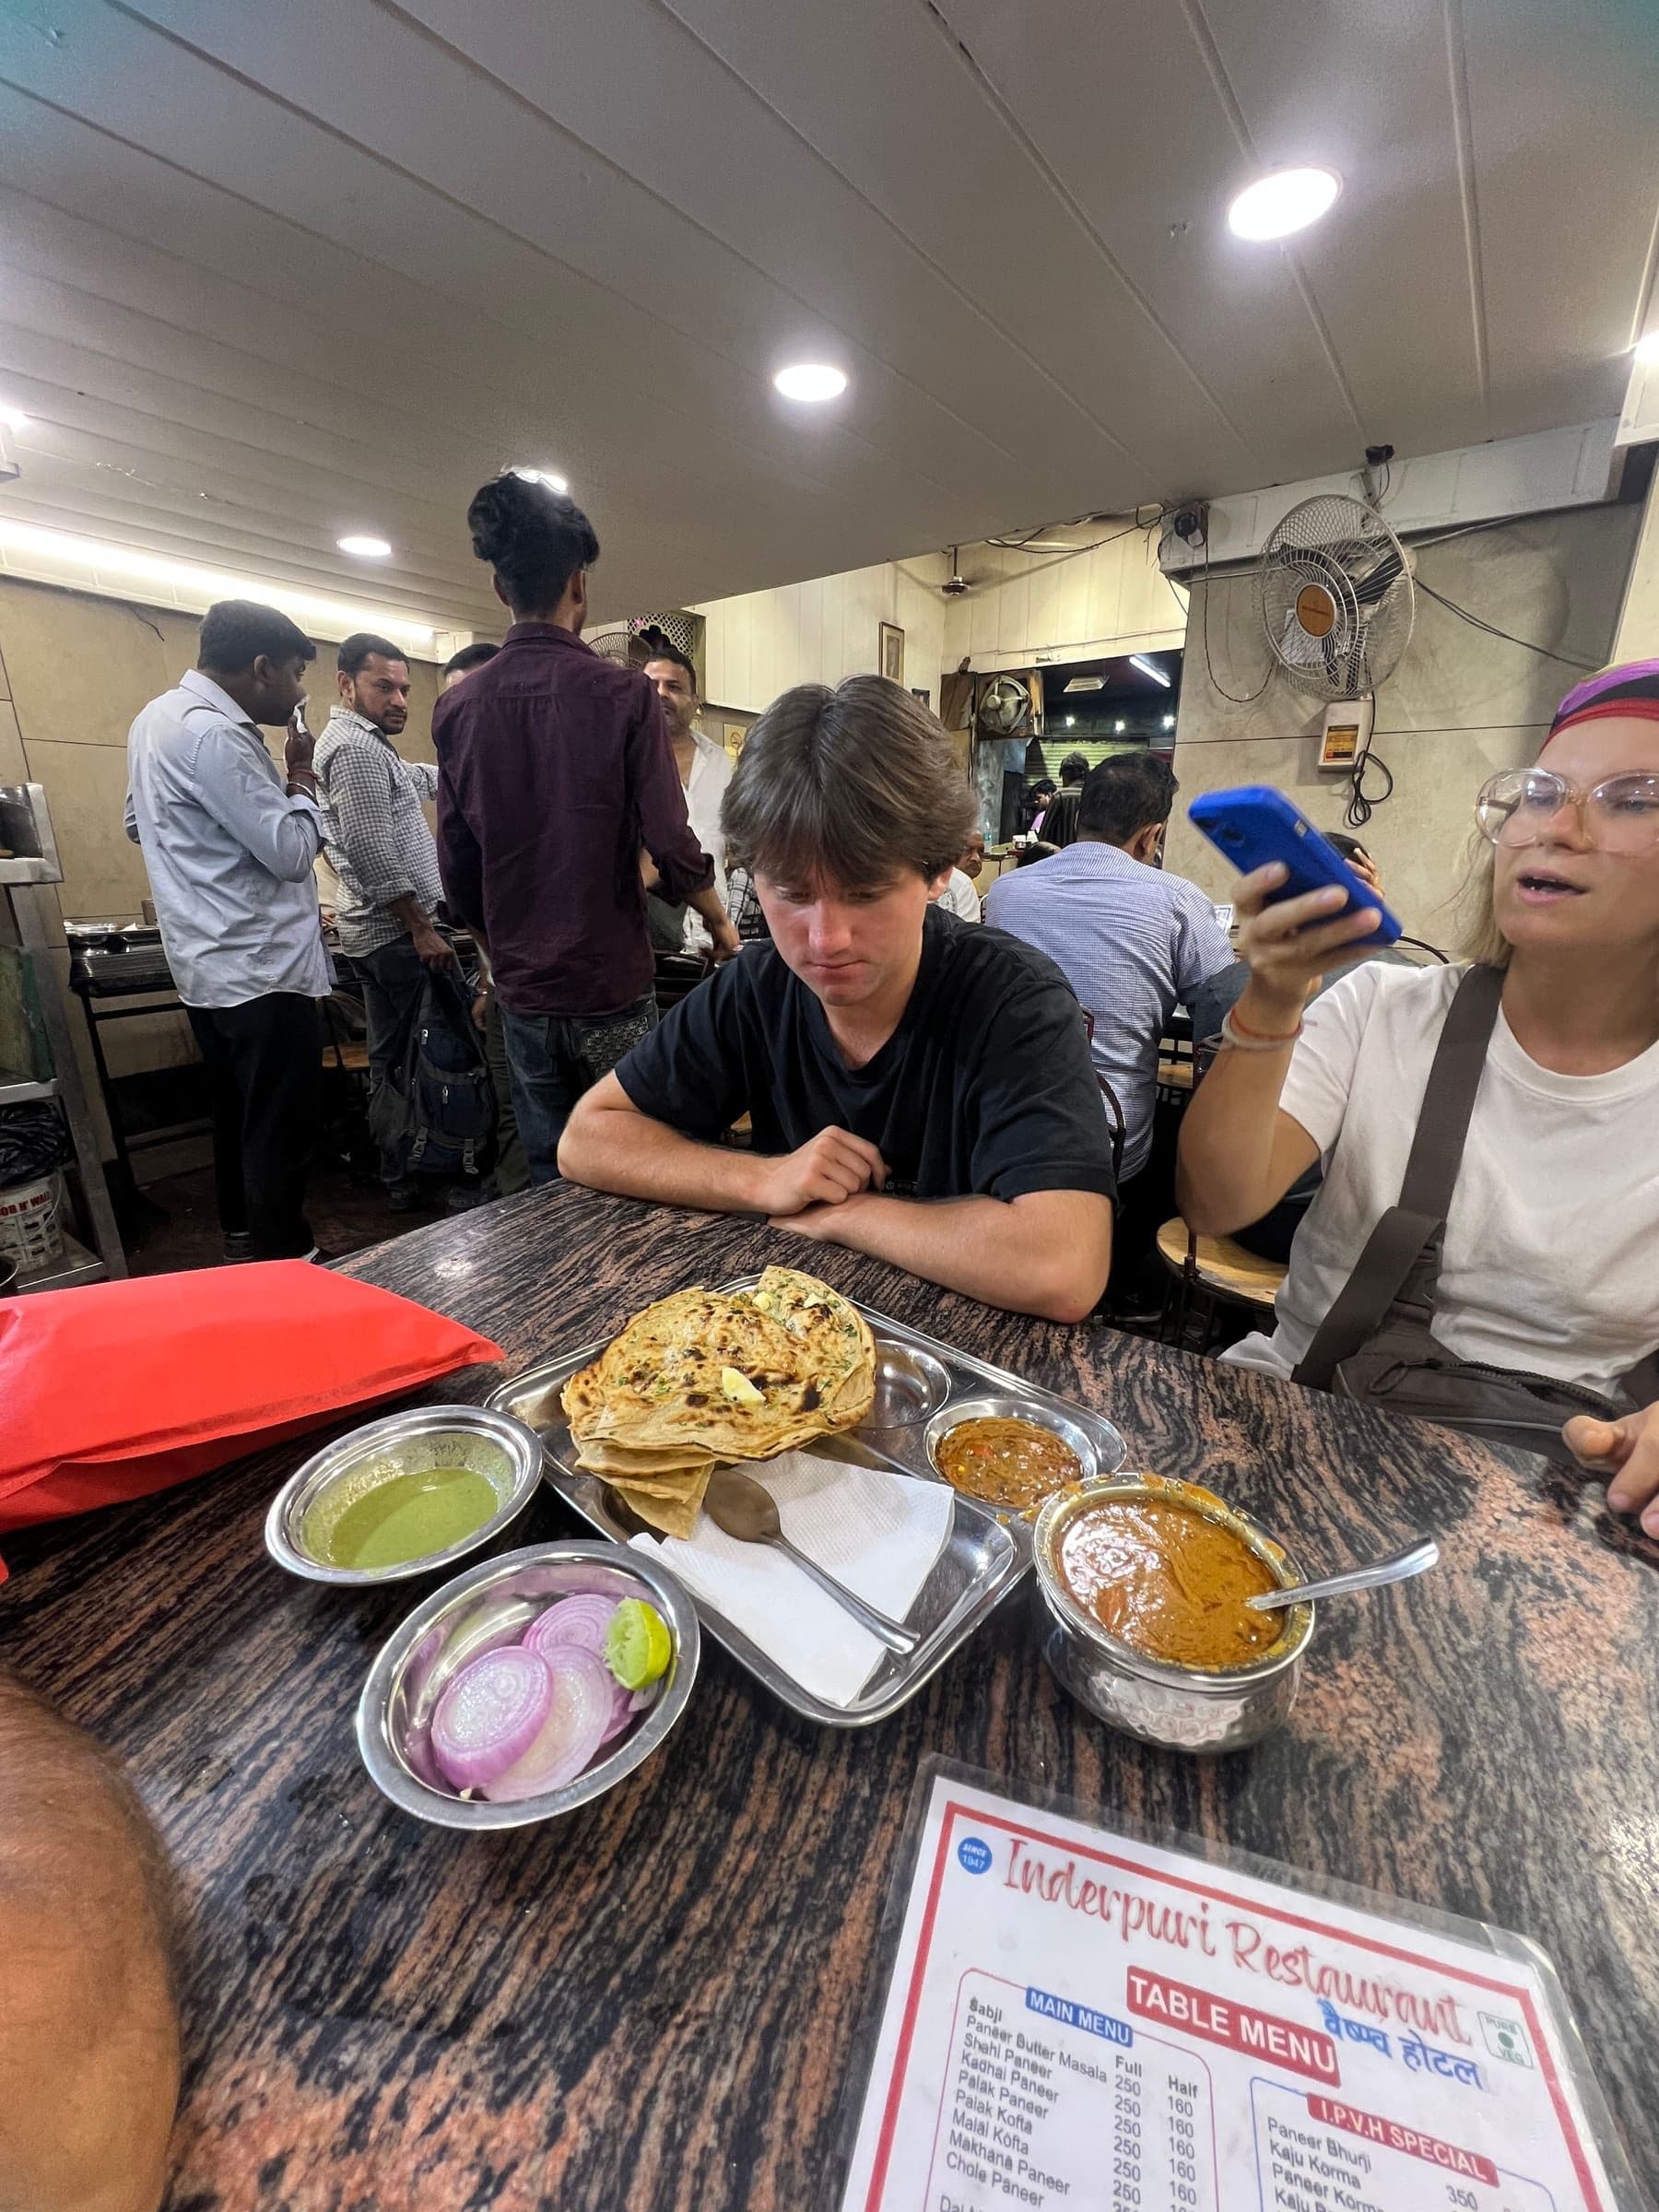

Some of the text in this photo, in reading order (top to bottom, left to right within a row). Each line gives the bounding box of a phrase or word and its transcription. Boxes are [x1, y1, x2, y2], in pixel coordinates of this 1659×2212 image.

[0, 1206, 17, 1217] OR
[961, 1843, 986, 1858] SINCE
[963, 1854, 985, 1869] 1947
[1003, 1839, 1474, 2046] Inderpuri Restaurant
[969, 1996, 1198, 2100] Sabji Full Half
[1030, 1991, 1130, 2044] MAIN MENU
[1129, 1974, 1335, 2074] TABLE MENU
[1398, 2029, 1484, 2090] होटल
[961, 2050, 1195, 2159] Kadhai Paneer 250 160
[964, 2032, 1194, 2138] Shahi Paneer 250 160
[966, 2015, 1194, 2117] Paneer Butter Masala 250 160
[949, 2129, 1070, 2195] Makhana Paneer
[952, 2108, 1141, 2205] Malai Kofta 250
[956, 2088, 1196, 2206] Palak Kofta 250 160
[959, 2070, 1196, 2183] Palak Paneer 250 160
[1267, 2116, 1478, 2211] Paneer Bhurji 350
[1270, 2138, 1361, 2190] Kaju Korma
[1321, 2100, 1488, 2181] I.P.V.H SPECIAL
[947, 2151, 1044, 2207] Chole Paneer
[1272, 2162, 1384, 2212] Paneer Korm
